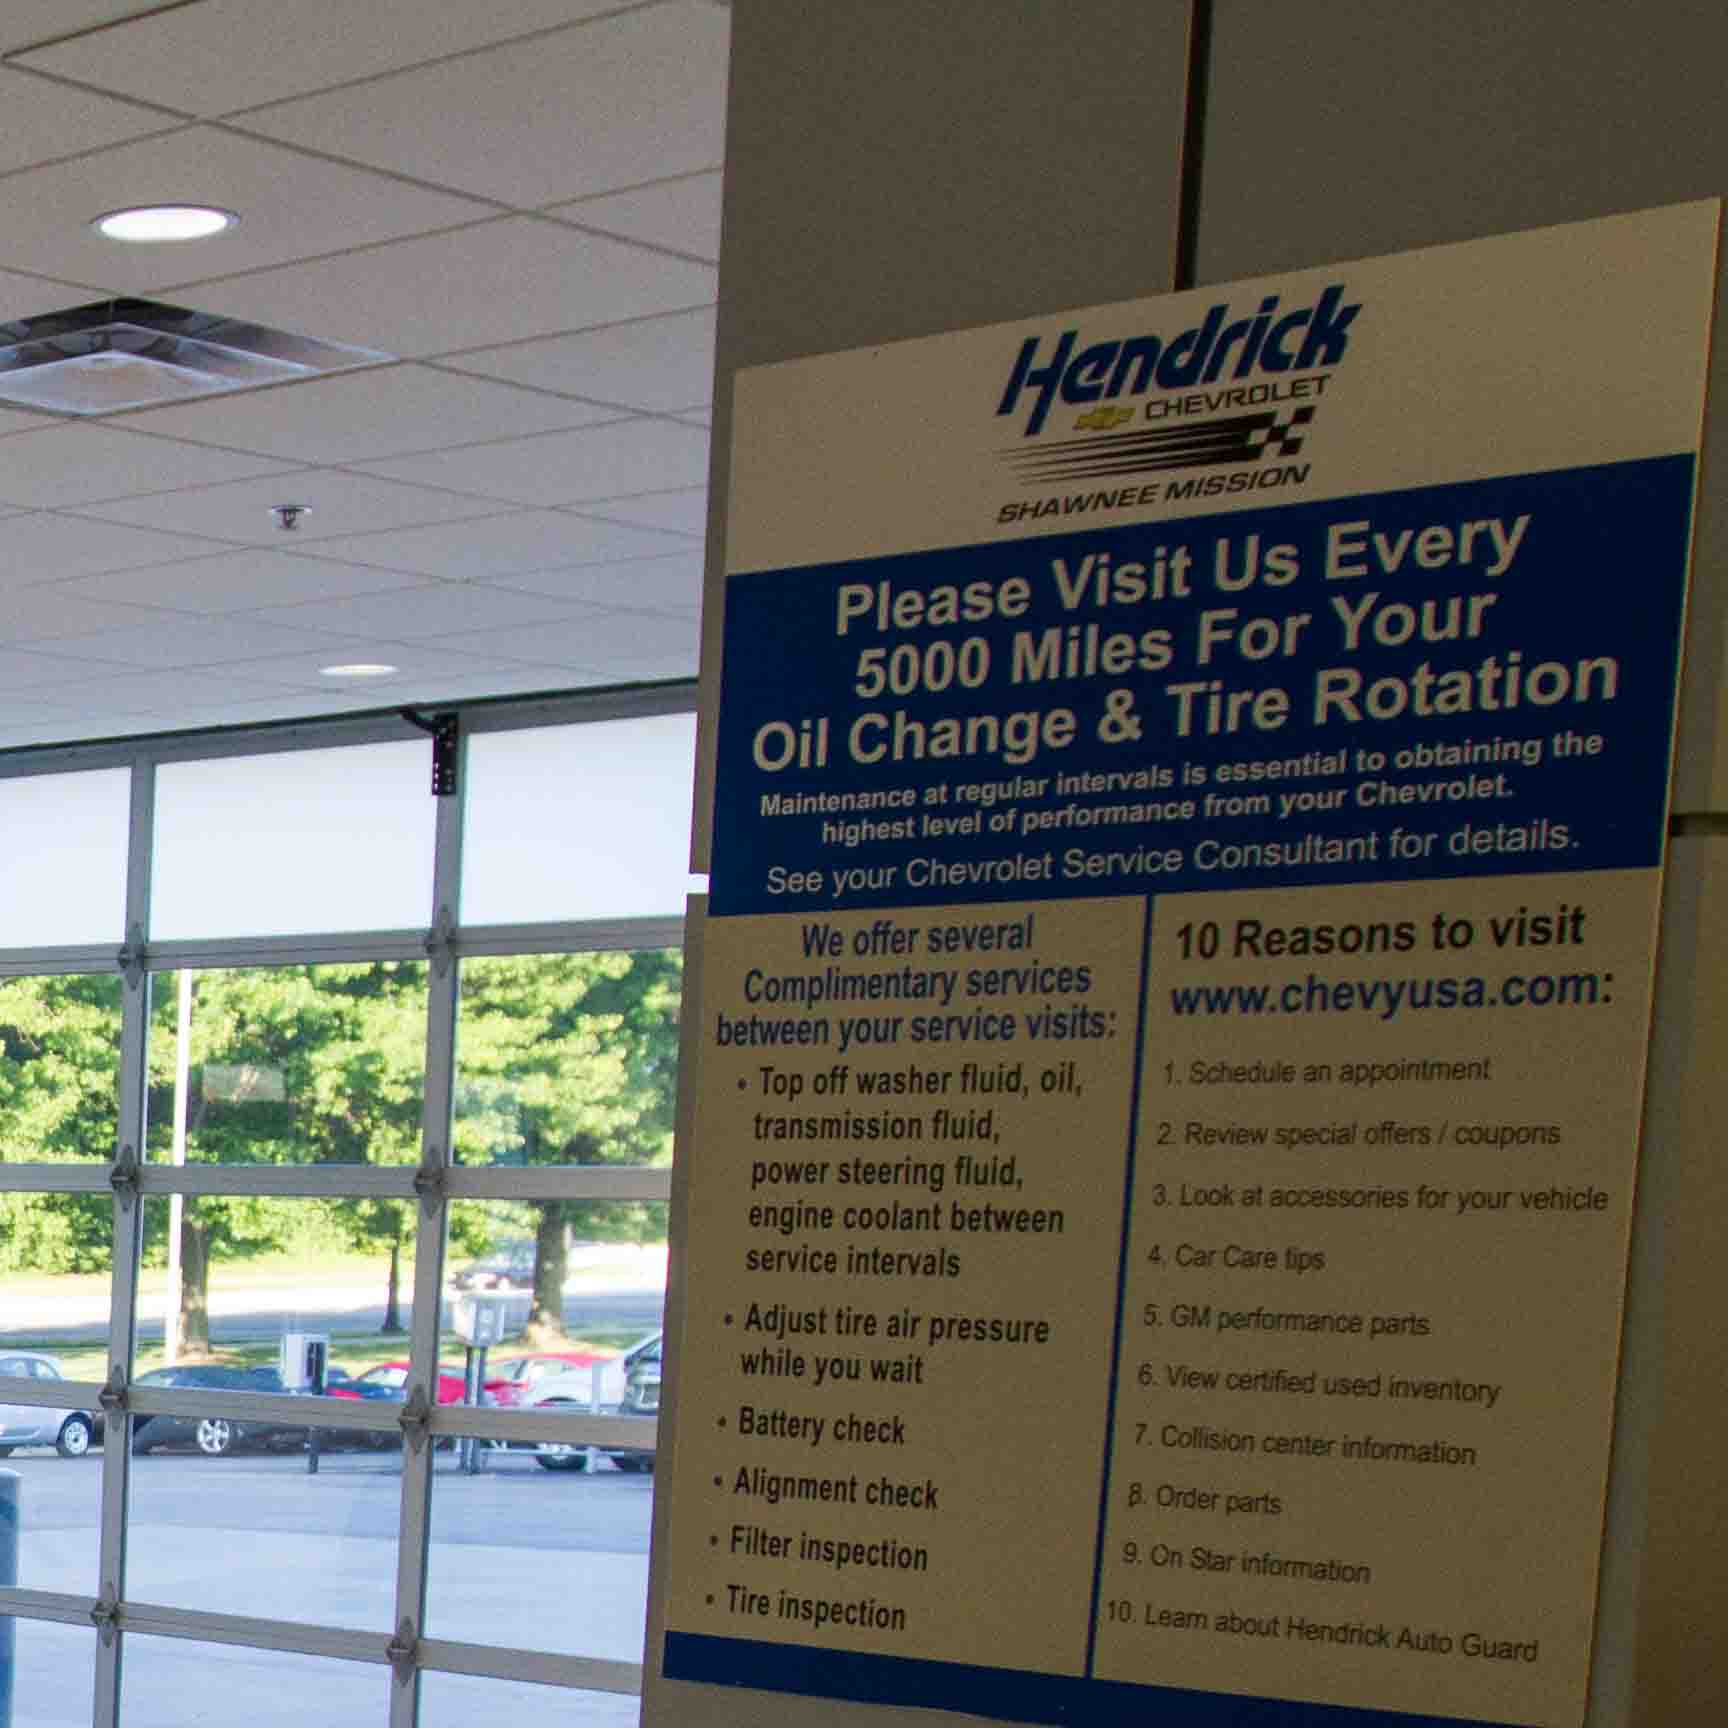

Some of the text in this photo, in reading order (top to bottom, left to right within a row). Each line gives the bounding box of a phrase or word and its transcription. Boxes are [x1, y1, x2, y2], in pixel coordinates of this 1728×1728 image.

[993, 283, 1364, 437] Hendrick
[1144, 375, 1332, 421] CHEVROLET
[995, 462, 1311, 525] SHAWNEE MISSION
[835, 513, 1531, 637] Please Visit Us Every
[854, 590, 1498, 700] 5000 Miles For Your
[752, 650, 1619, 774] Oil Change & Tire Rotation
[759, 730, 1604, 818] Maintenance at regular intervals is essential to obtaining the
[821, 776, 1514, 845] highest level of performance from your Chevrolet.
[766, 820, 1580, 901] See your Chevrolet Service Consultant for details.
[801, 914, 1035, 958] We offer several
[1174, 904, 1587, 962] 10 Reasons to visit
[743, 962, 1093, 1011] Complimentary services
[1171, 967, 1614, 1024] www.chevyusa.com:
[715, 1006, 1118, 1052] between your service visits:
[757, 1062, 1084, 1101] Top off washer fluid, oil,
[1188, 1058, 1296, 1087] Schedule
[1303, 1058, 1333, 1084] an
[1338, 1057, 1491, 1087] appointment
[752, 1109, 1001, 1146] transmission fluid,
[1184, 1121, 1269, 1148] Review
[1274, 1119, 1355, 1151] special
[1362, 1119, 1430, 1146] offers
[1453, 1119, 1562, 1150] coupons
[751, 1155, 1025, 1192] power steering fluid,
[748, 1202, 1064, 1236] engine coolant between
[1152, 1182, 1609, 1217] 3. Look at accessories for your vehicle
[746, 1245, 962, 1280] service intervals
[1174, 1243, 1218, 1270] Car
[1225, 1243, 1277, 1271] Care
[1284, 1243, 1325, 1275] tips
[744, 1304, 1050, 1348] Adjust tire air pressure
[1169, 1304, 1210, 1331] GM
[1216, 1304, 1362, 1339] performance
[1369, 1309, 1431, 1339] parts
[739, 1348, 923, 1389] while you wait
[1164, 1363, 1218, 1392] View
[1223, 1365, 1316, 1395] certified
[1323, 1370, 1381, 1397] used
[1387, 1373, 1503, 1407] inventory
[737, 1405, 906, 1446] Battery check
[1159, 1424, 1254, 1453] Collision
[1260, 1429, 1337, 1458] center
[1343, 1431, 1477, 1466] information
[733, 1466, 940, 1512] Alignment check
[1154, 1485, 1220, 1514] Order
[1225, 1488, 1282, 1521] parts
[729, 1524, 929, 1573] Filter inspection
[1149, 1543, 1183, 1571] On
[1191, 1546, 1237, 1575] Star
[1242, 1549, 1372, 1585] information
[725, 1583, 908, 1632] Tire inspection
[1144, 1602, 1208, 1632] Learn
[1215, 1609, 1279, 1639] about
[1286, 1614, 1391, 1649] Hendrick
[1398, 1622, 1453, 1654] Auto
[1462, 1632, 1540, 1665] Guard
